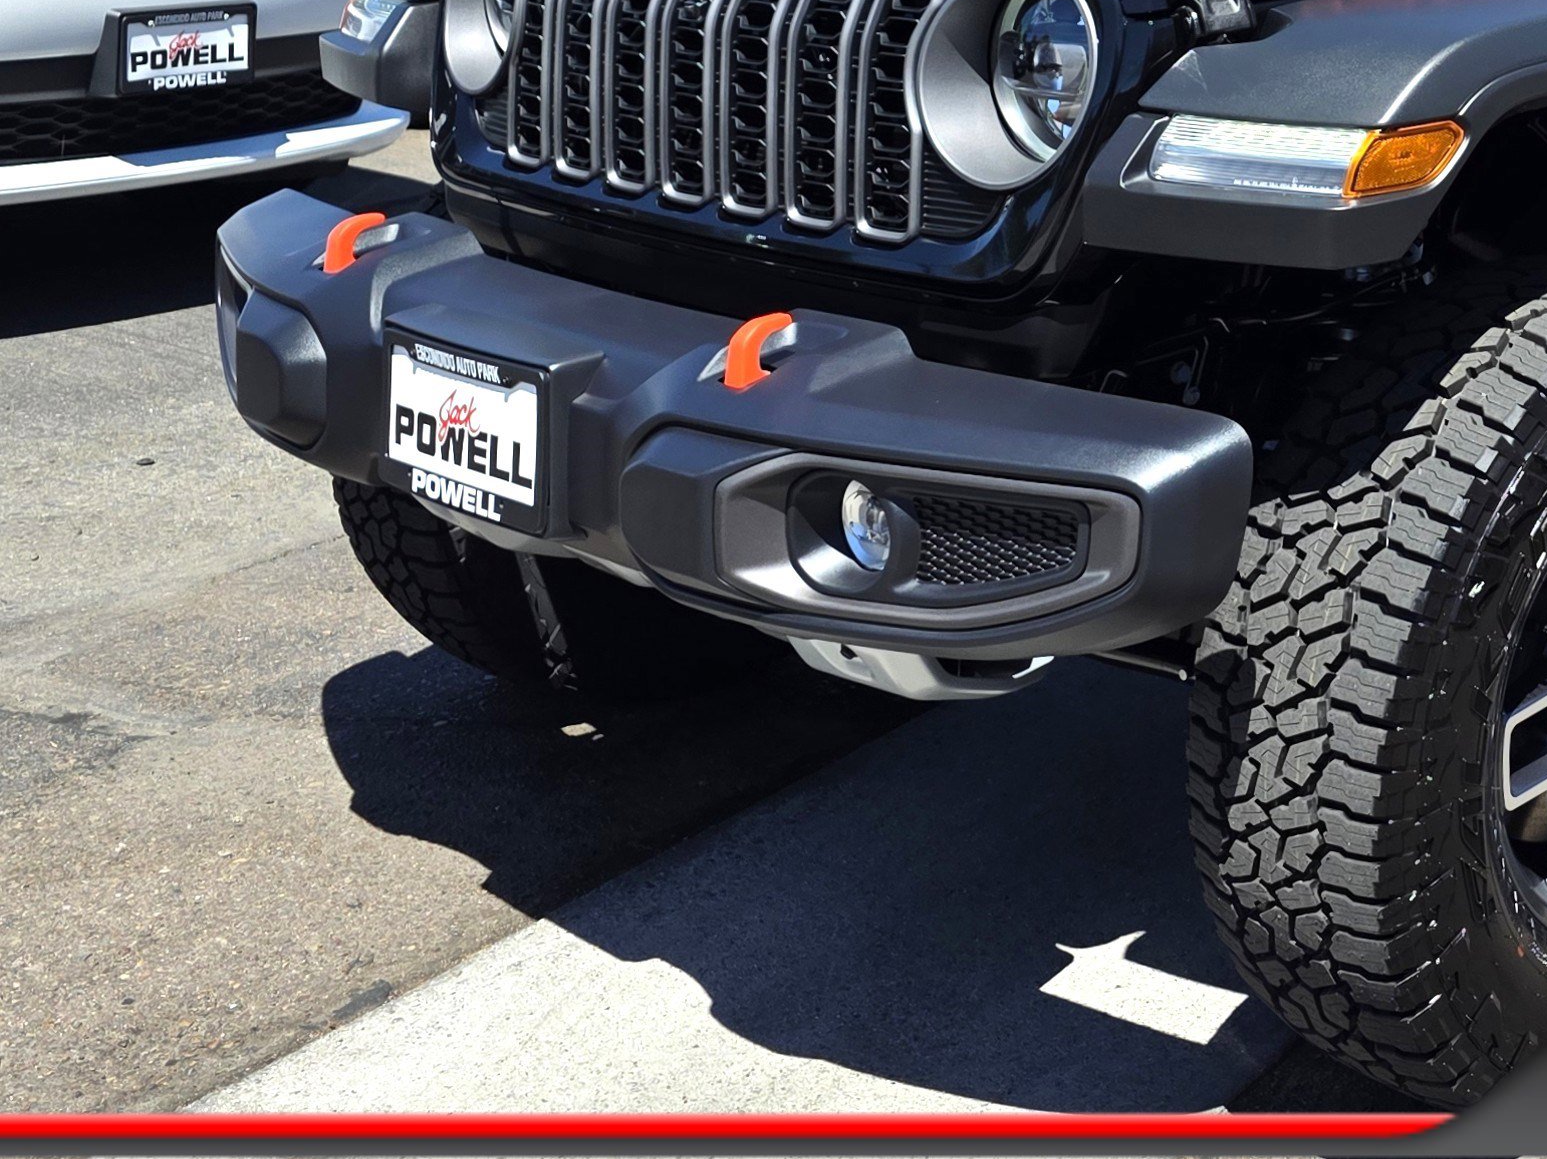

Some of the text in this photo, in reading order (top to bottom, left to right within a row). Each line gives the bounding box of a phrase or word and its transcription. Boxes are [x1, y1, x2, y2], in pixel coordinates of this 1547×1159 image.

[130, 42, 245, 73] POWELL
[153, 70, 227, 92] POWELL
[438, 389, 480, 443] Jack
[394, 403, 533, 490] POWELL
[411, 468, 502, 522] POWELL
